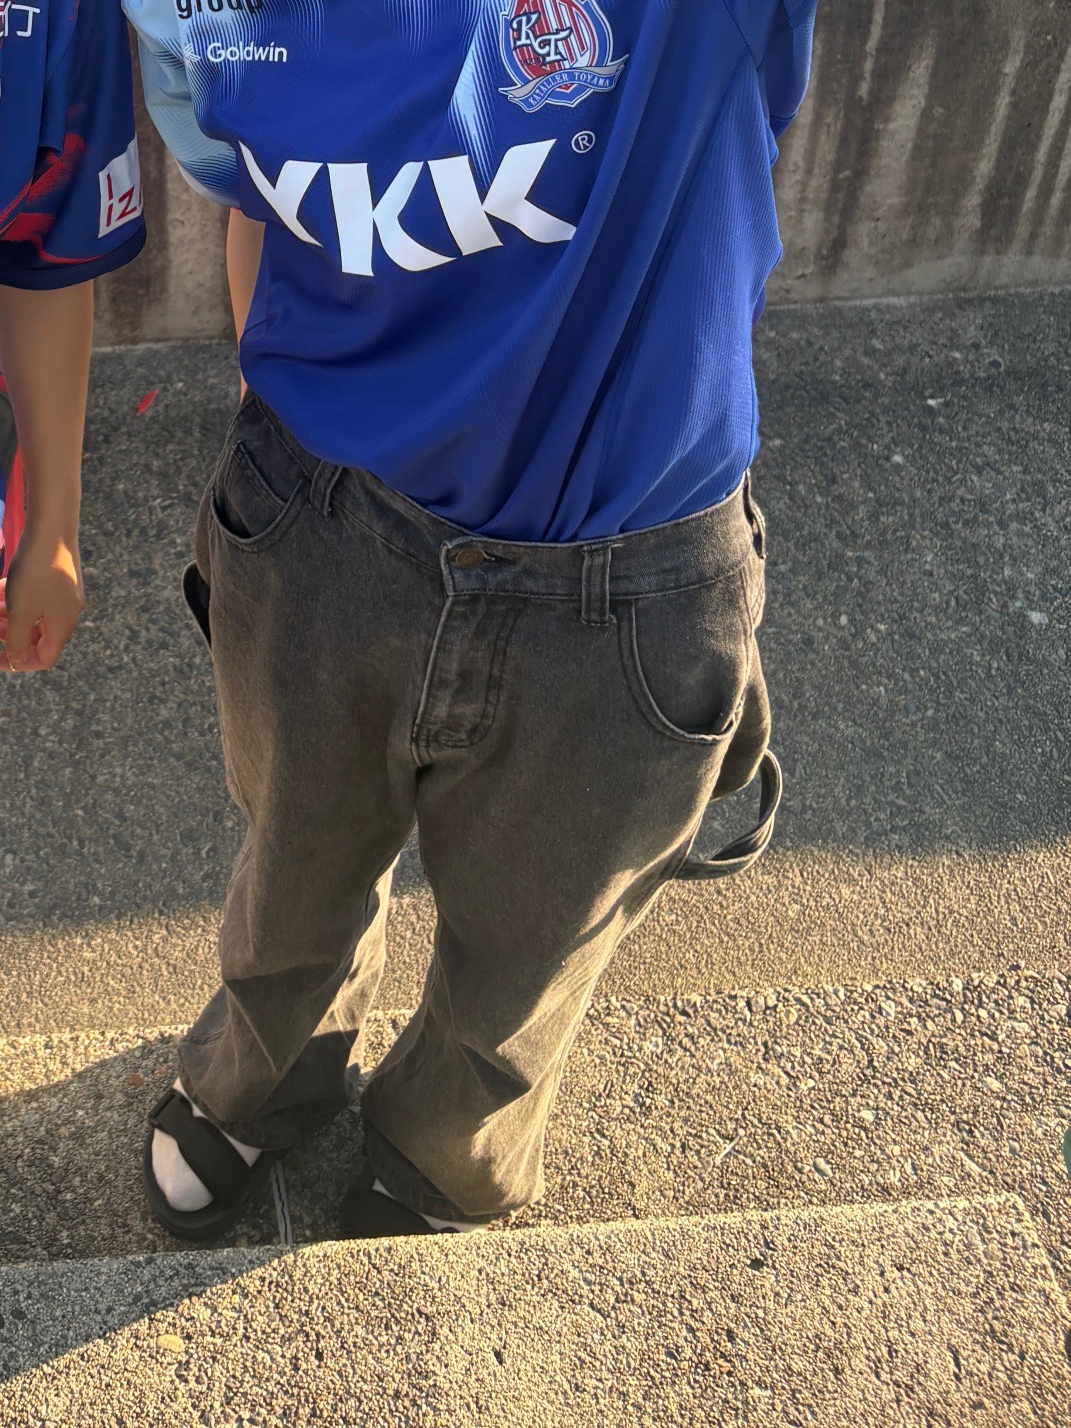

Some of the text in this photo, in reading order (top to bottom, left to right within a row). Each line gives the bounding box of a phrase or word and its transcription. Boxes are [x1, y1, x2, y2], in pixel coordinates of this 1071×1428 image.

[206, 40, 288, 63] Goldwin
[528, 71, 610, 107] KATALLER TOYAMA
[238, 138, 578, 277] YKK
